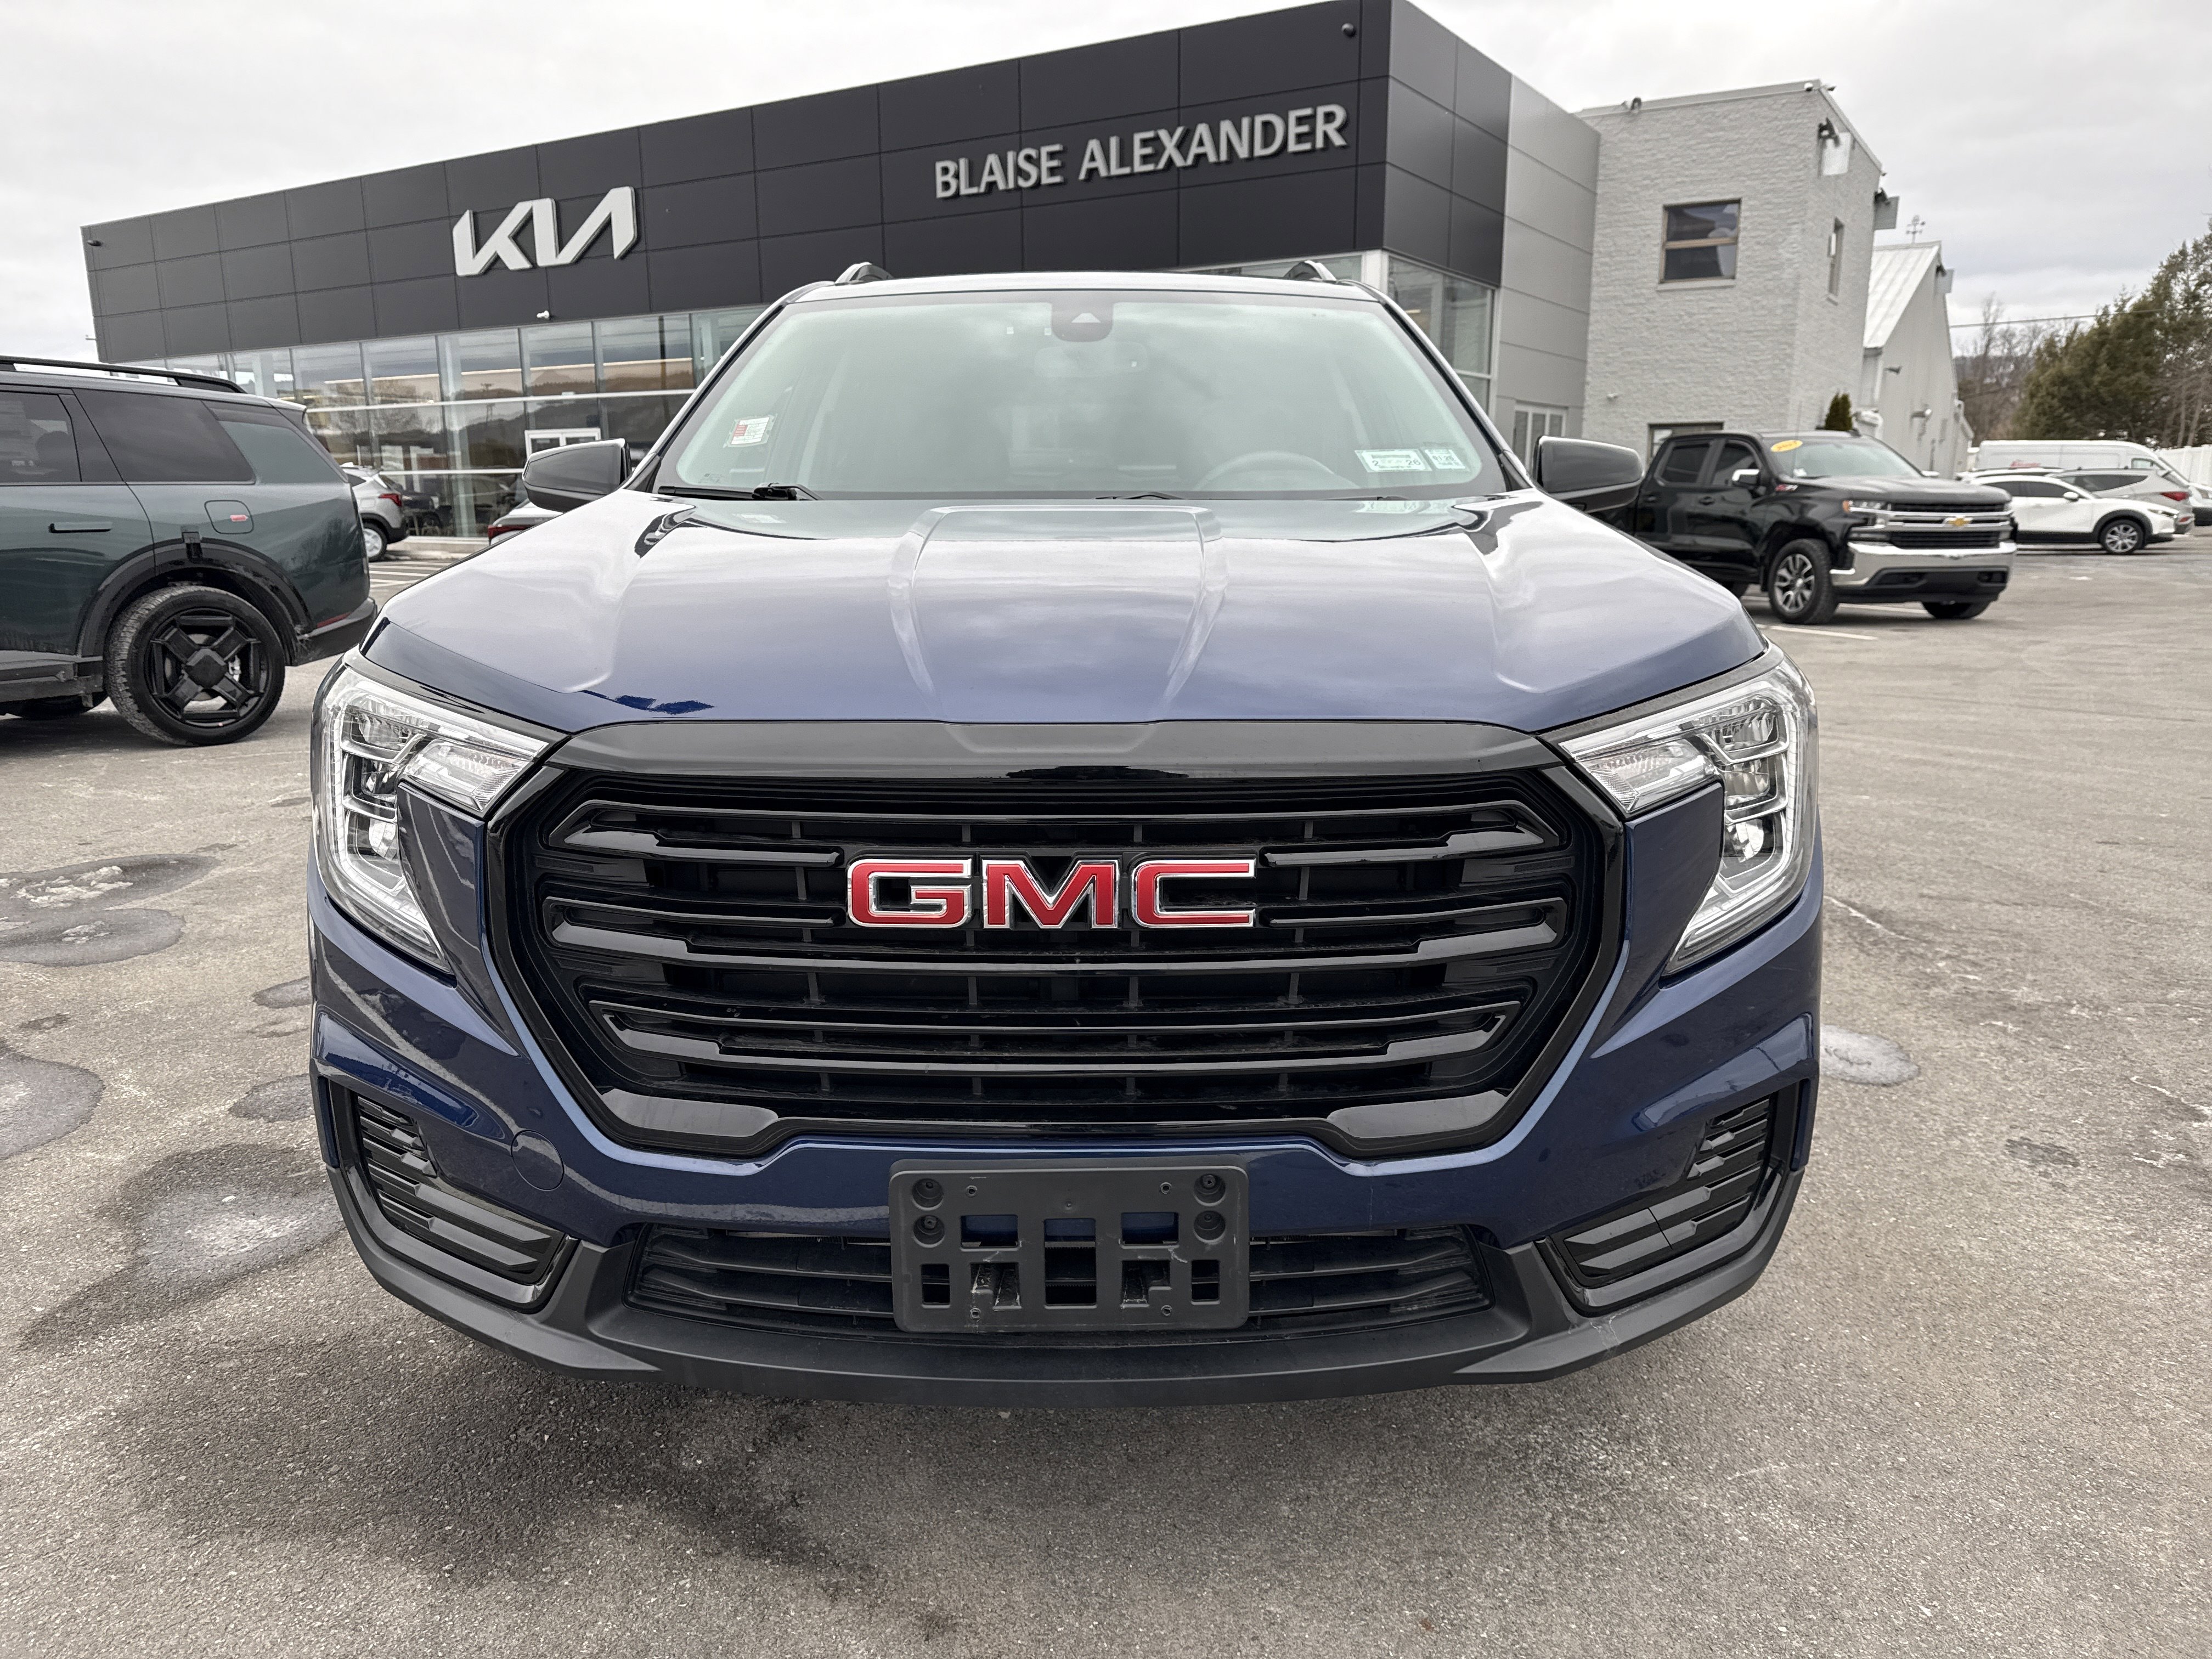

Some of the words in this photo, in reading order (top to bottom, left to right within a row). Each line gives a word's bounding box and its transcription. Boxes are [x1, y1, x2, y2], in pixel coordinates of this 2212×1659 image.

[935, 143, 1064, 199] BLAISE
[1079, 103, 1347, 180] ALEXANDER
[453, 186, 637, 276] KIA
[847, 859, 1256, 929] GMC
